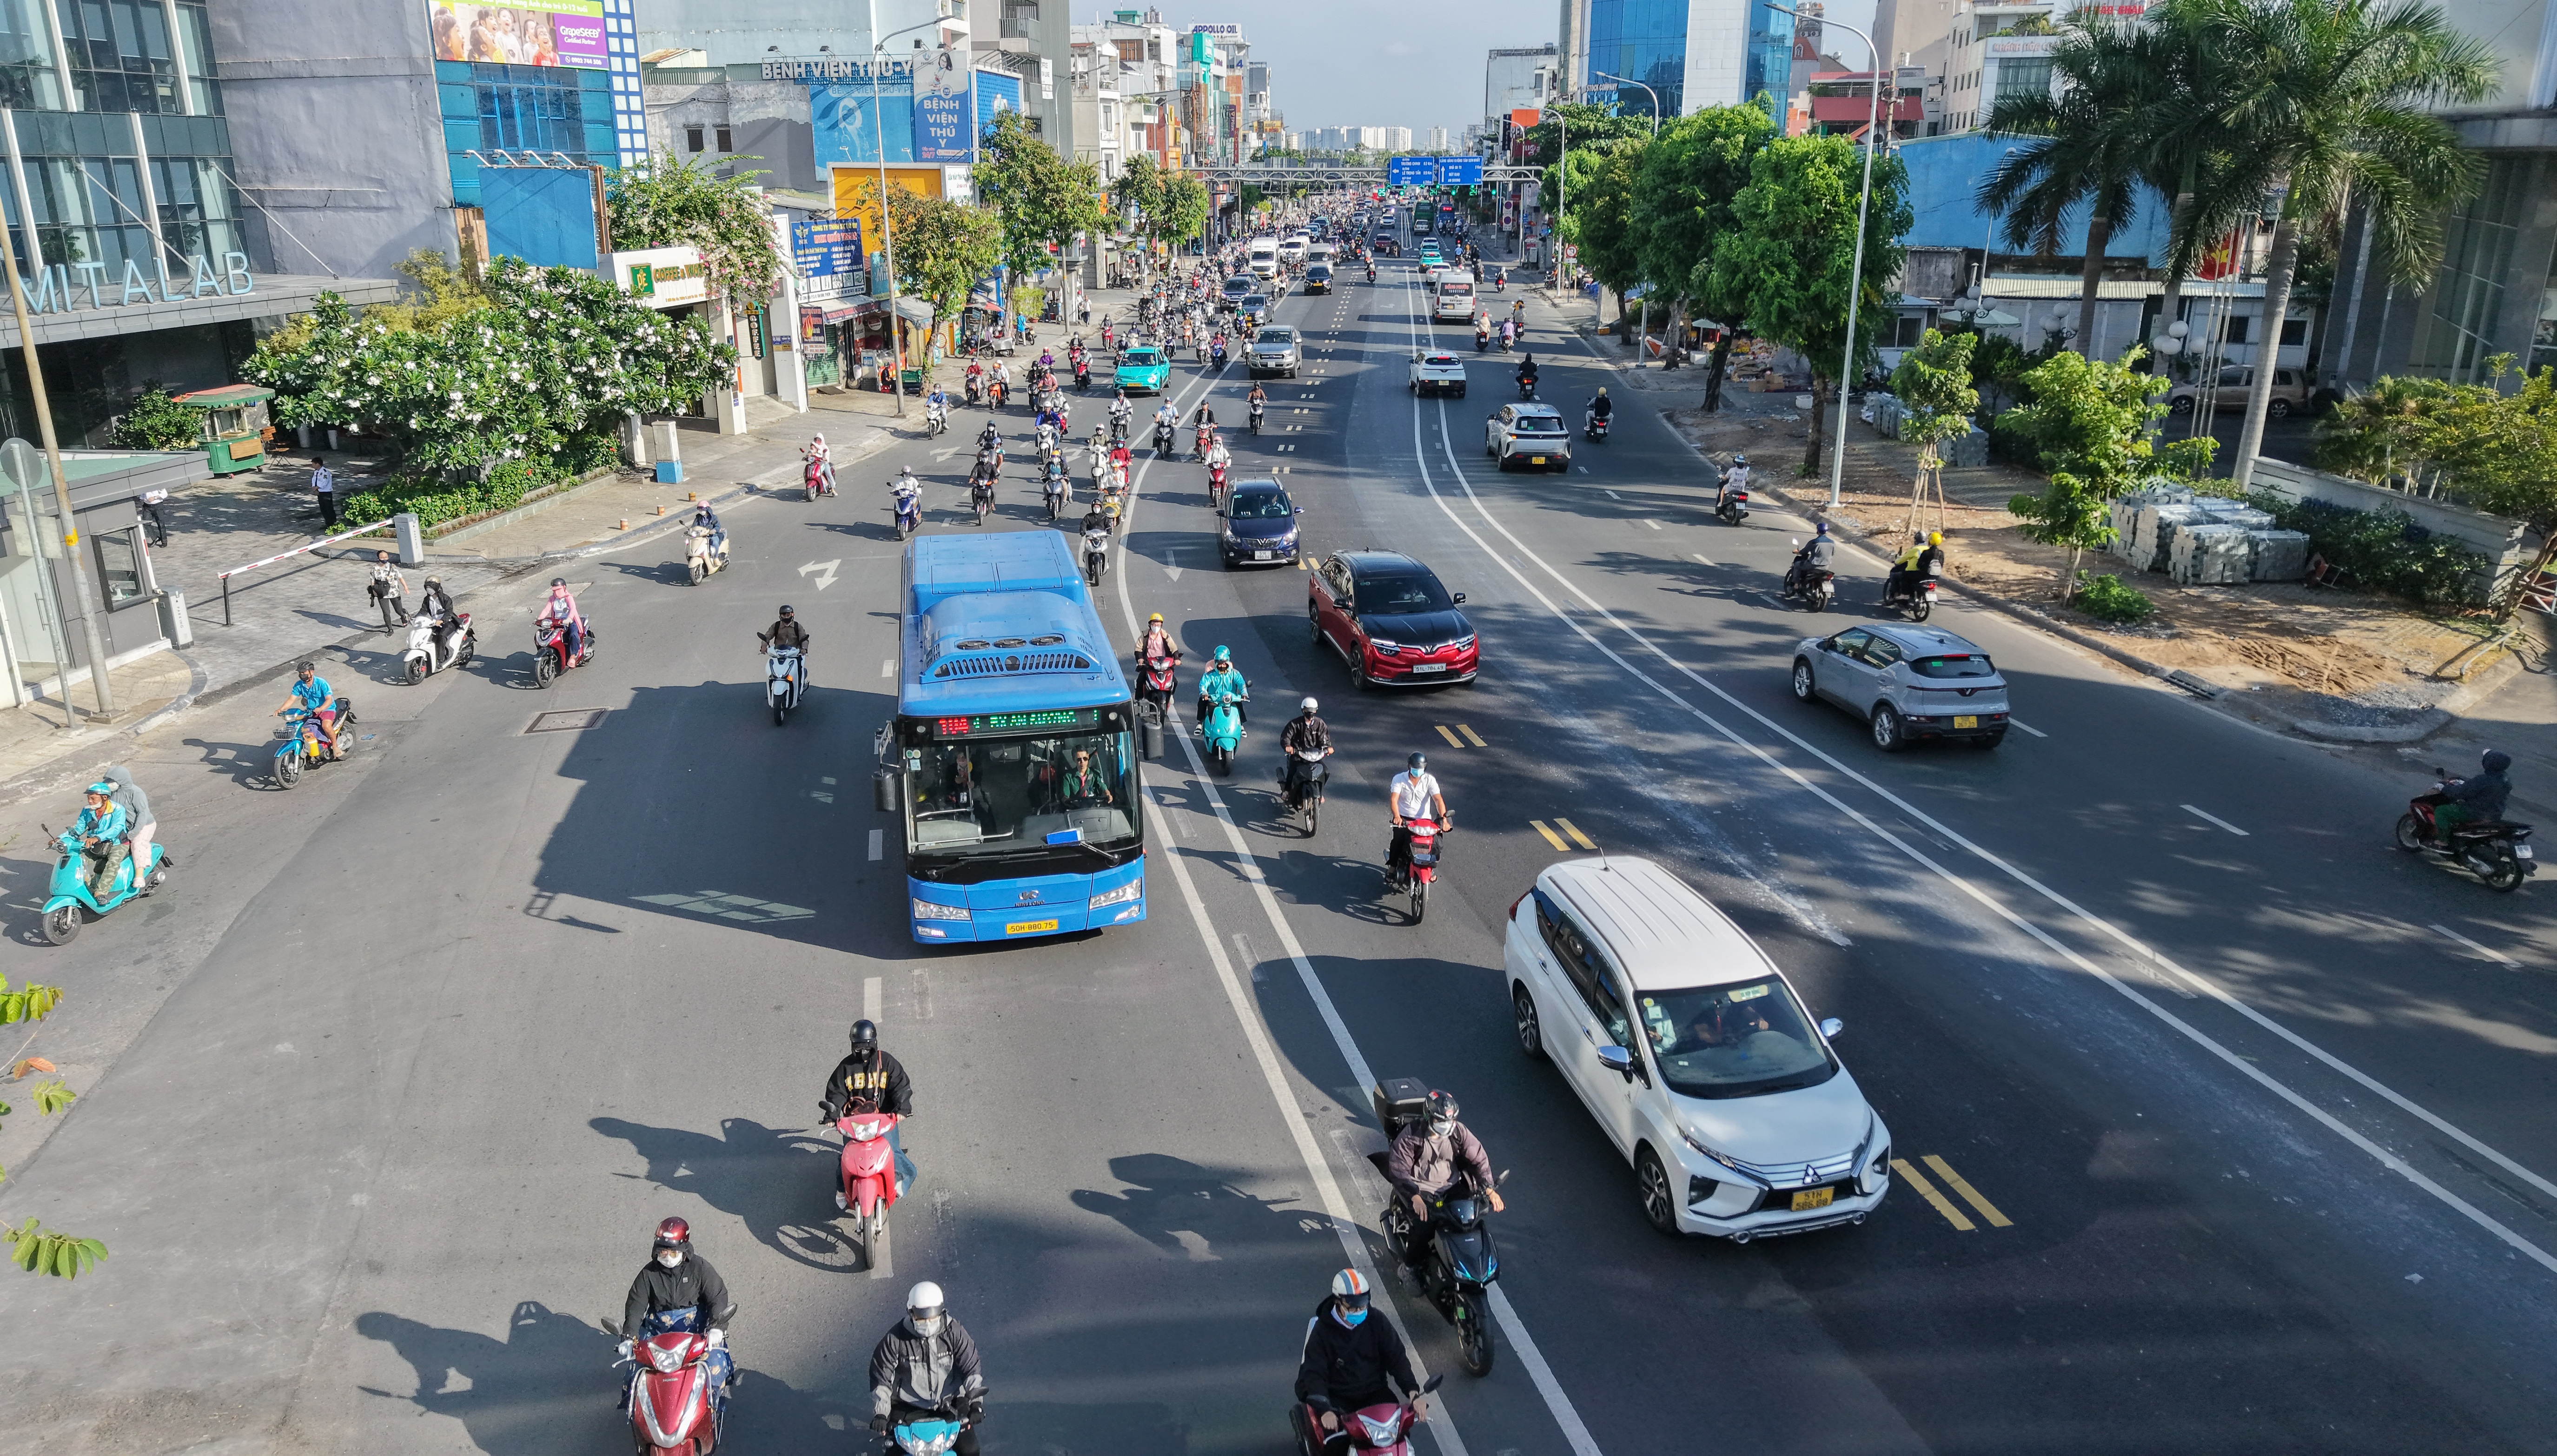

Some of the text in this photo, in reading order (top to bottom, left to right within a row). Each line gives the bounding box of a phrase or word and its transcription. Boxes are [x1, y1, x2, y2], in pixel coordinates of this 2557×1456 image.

[560, 26, 599, 38] GrapeSEED
[1192, 25, 1225, 33] APPOLLO
[1599, 83, 1617, 91] COMPANY
[923, 97, 959, 112] BỆNH
[927, 112, 958, 126] VIỆN
[929, 126, 956, 137] THÚ
[938, 139, 947, 148] Y
[814, 234, 827, 244] INOX
[827, 231, 841, 243] QUỐC
[653, 266, 680, 283] COFFEE
[750, 315, 762, 357] COFFEE
